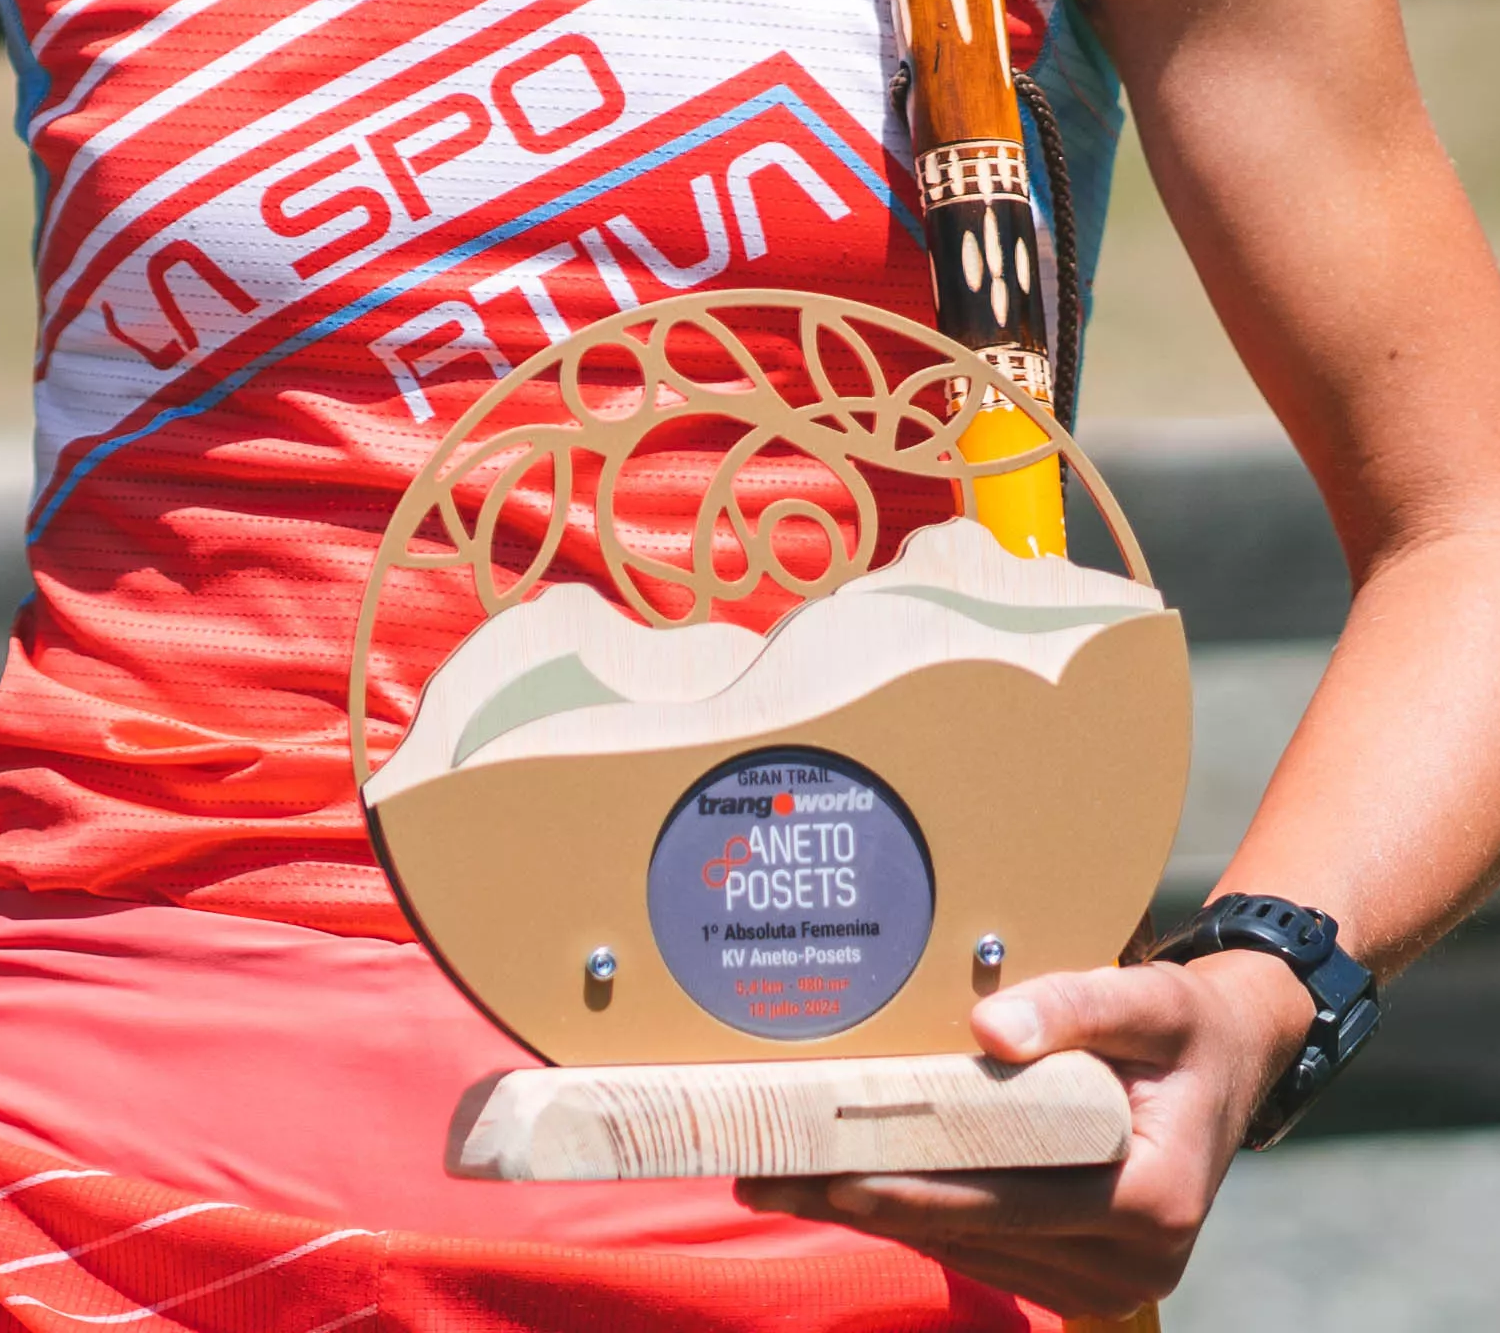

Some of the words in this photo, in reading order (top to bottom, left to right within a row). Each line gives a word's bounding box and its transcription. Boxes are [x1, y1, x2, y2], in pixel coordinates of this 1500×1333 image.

[261, 32, 626, 281] SPO
[737, 769, 782, 787] GRAN
[787, 767, 834, 785] TRAIL
[749, 822, 855, 865] ANETO
[725, 866, 857, 911] POSETS
[724, 921, 797, 941] Absoluta
[801, 918, 881, 938] Femenina
[722, 948, 746, 968] KV
[750, 945, 862, 966] Aneto-Posets
[804, 997, 840, 1017] 2024
